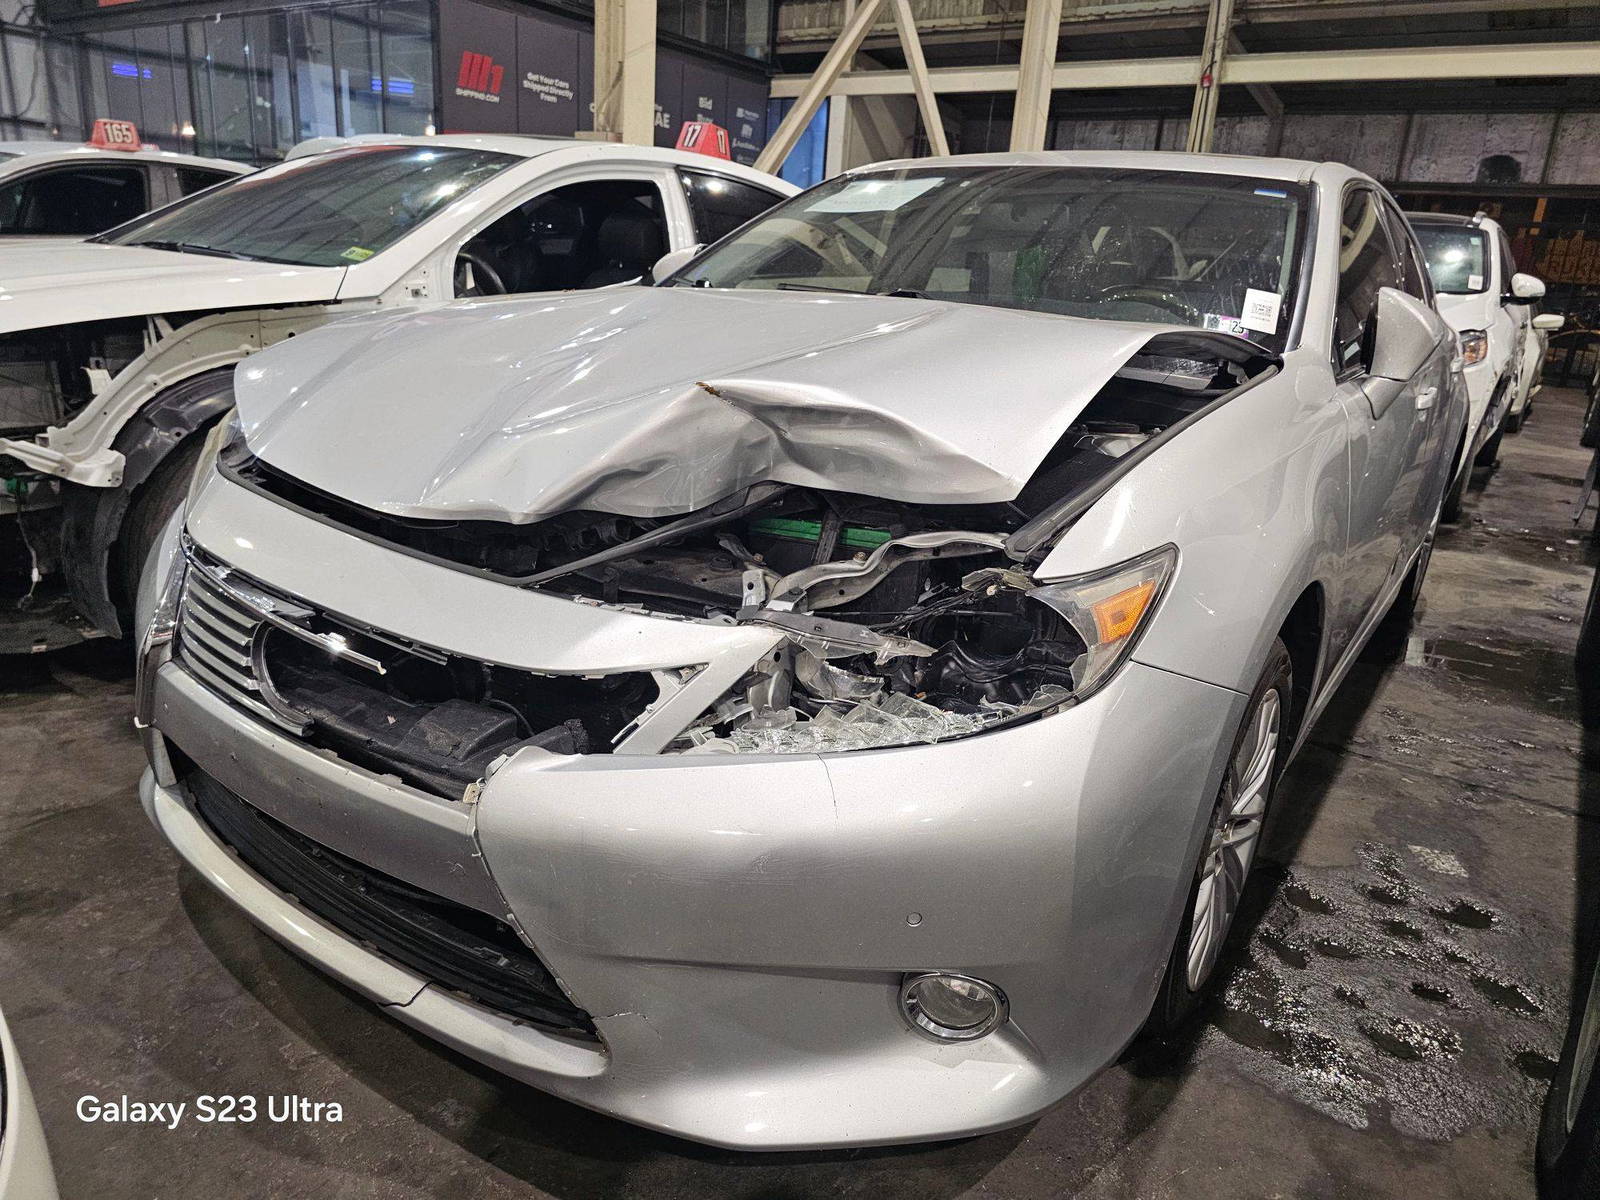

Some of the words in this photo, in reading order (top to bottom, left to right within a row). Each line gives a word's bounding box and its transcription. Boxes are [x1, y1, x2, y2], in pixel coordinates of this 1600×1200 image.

[527, 72, 540, 82] Get
[539, 75, 555, 86] Your
[554, 79, 570, 89] Cars
[523, 80, 550, 93] Shipped
[549, 86, 574, 100] Directly
[540, 93, 558, 103] From
[655, 112, 671, 129] AE
[104, 122, 133, 144] 165
[683, 124, 702, 148] 17
